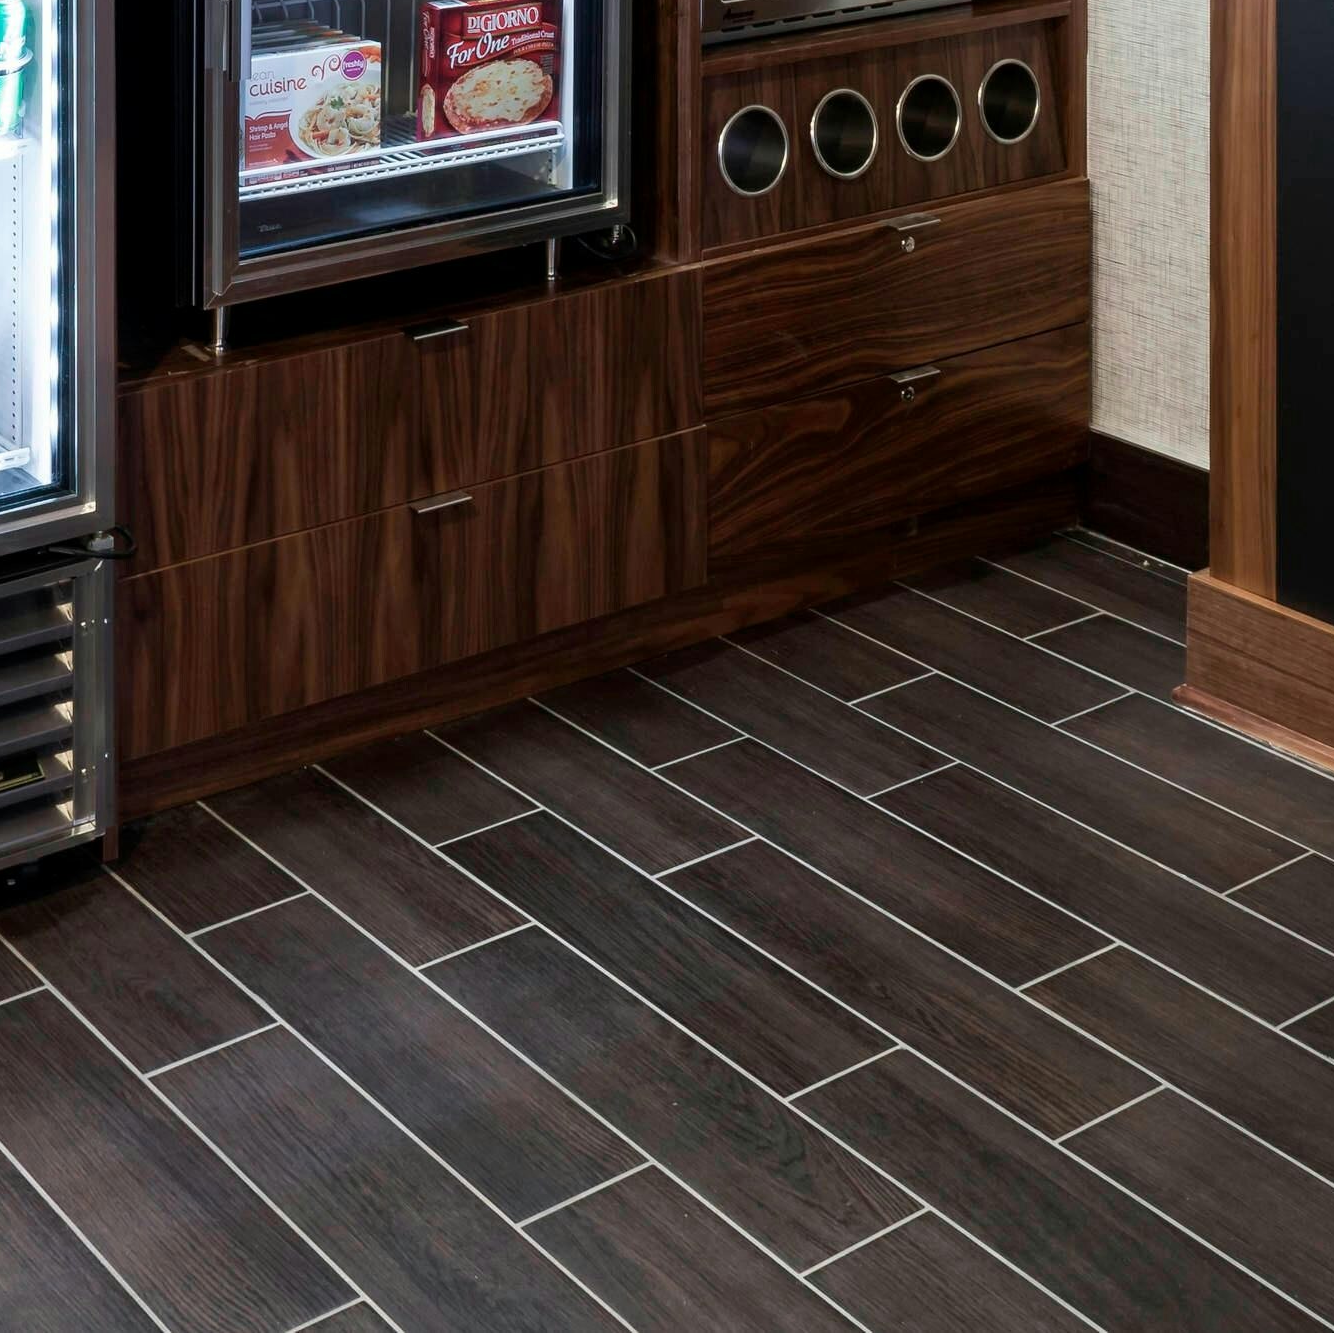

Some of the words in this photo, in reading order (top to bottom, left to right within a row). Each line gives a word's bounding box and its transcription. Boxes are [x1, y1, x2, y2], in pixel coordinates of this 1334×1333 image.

[447, 40, 476, 69] For
[476, 32, 509, 60] One
[249, 76, 307, 97] cuisine
